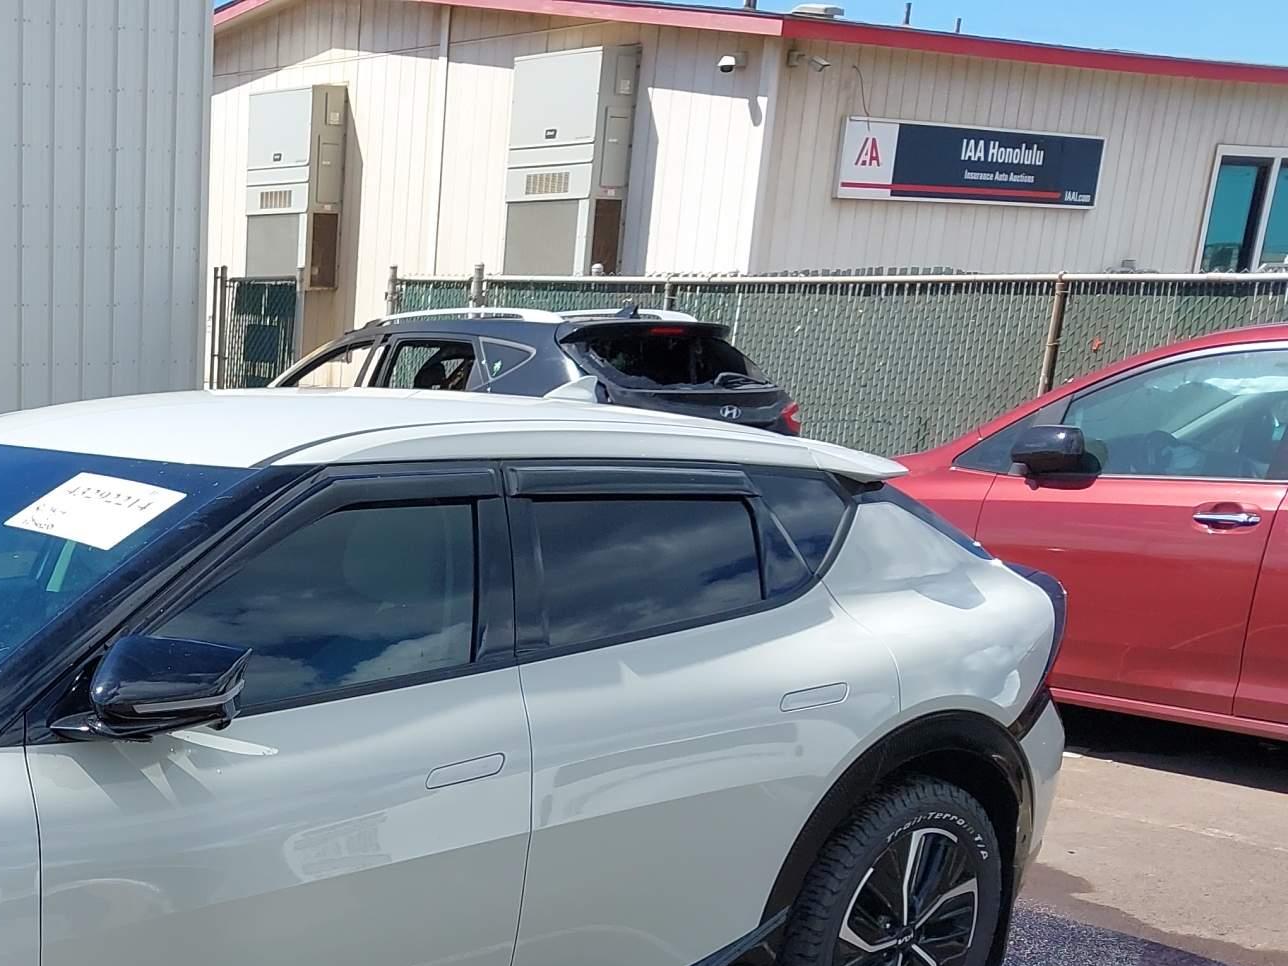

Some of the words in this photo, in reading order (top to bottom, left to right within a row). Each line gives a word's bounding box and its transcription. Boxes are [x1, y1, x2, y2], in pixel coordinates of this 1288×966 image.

[961, 138, 985, 161] IAA
[988, 141, 1044, 166] Honolulu
[964, 169, 994, 181] Insurance
[994, 171, 1009, 182] Auto
[1009, 172, 1035, 183] Auctions
[886, 811, 976, 843] Trail-Terrain
[974, 833, 989, 861] T/A
